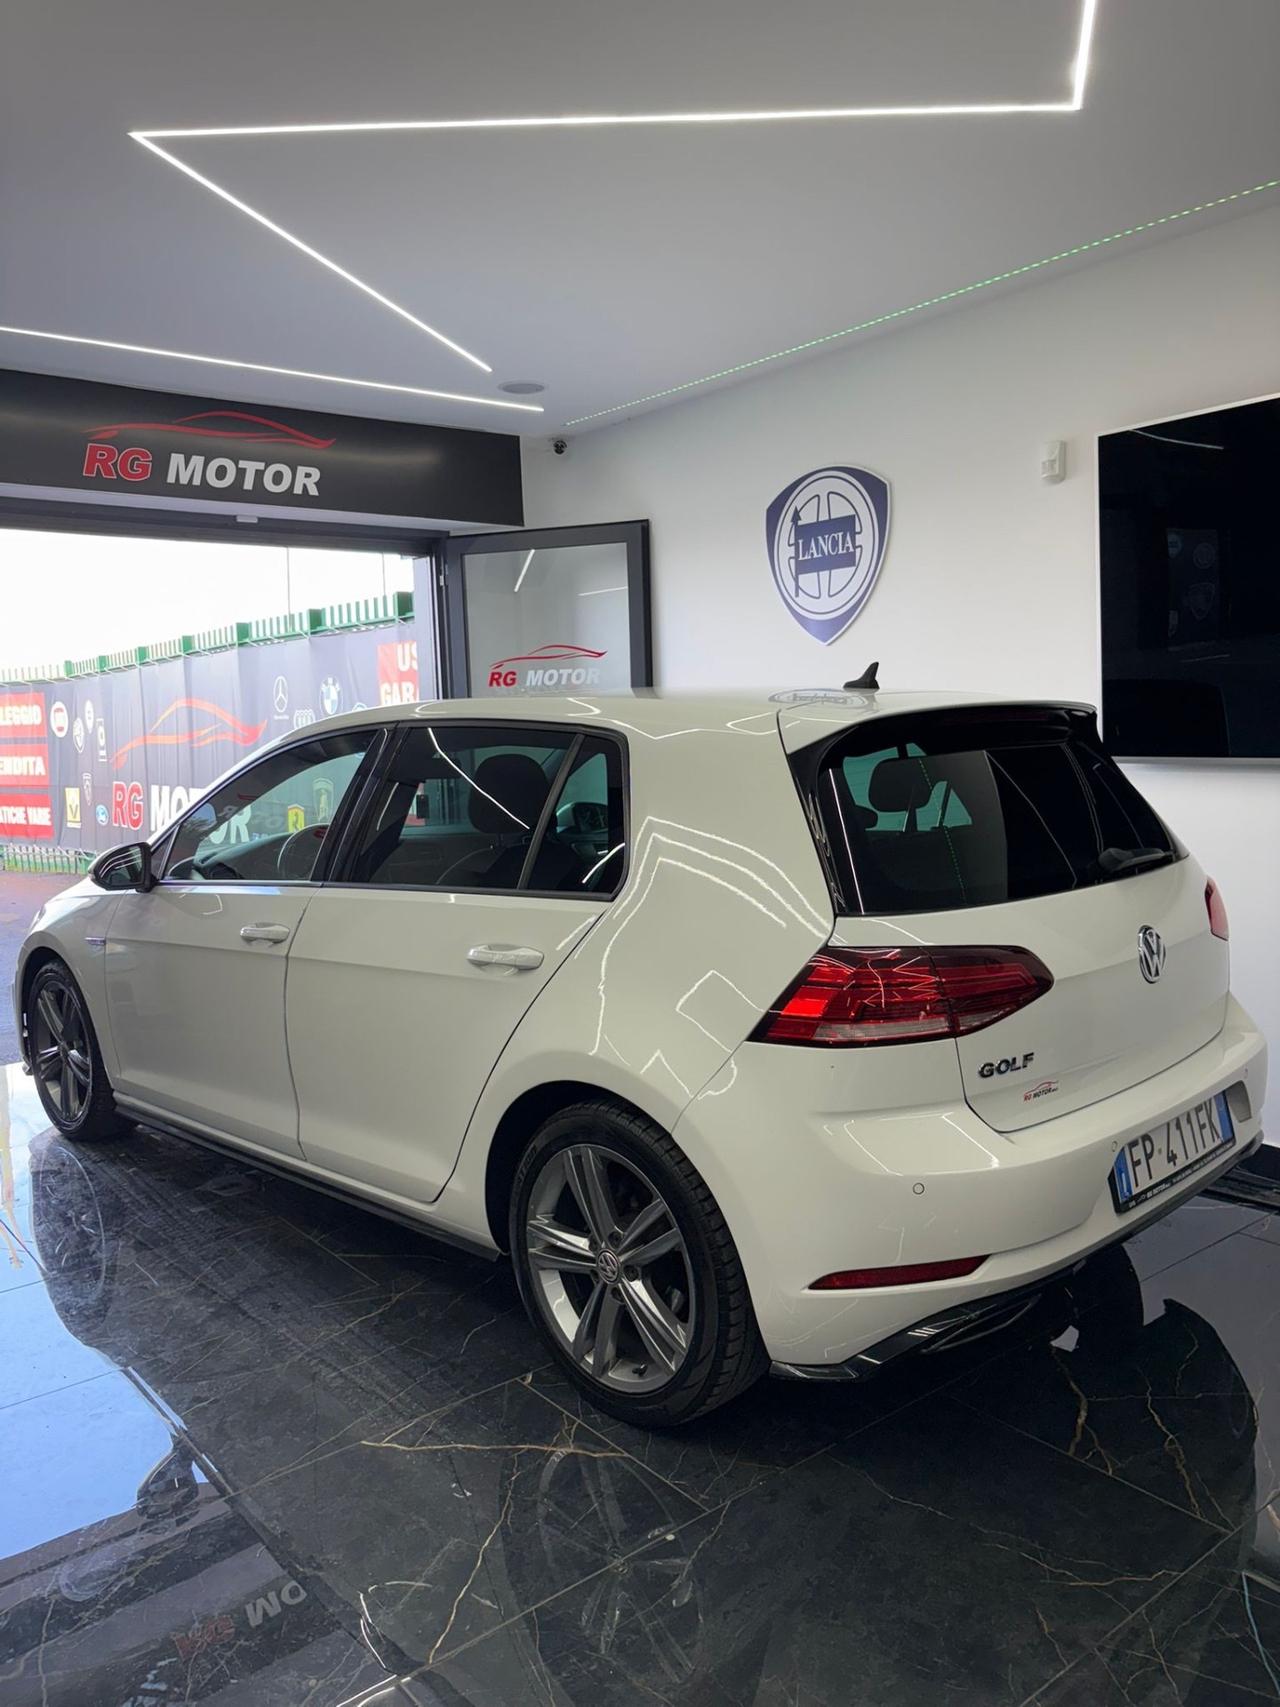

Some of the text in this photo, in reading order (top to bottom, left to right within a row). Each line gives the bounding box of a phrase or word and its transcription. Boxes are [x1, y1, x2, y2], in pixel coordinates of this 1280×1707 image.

[83, 443, 321, 496] RG MOTOR
[798, 531, 855, 560] LANCIA
[488, 668, 600, 687] RG MOTOR
[380, 681, 420, 706] GAR
[112, 781, 144, 831] RG
[978, 1052, 1035, 1078] GOLF
[1128, 1132, 1155, 1188] FP
[1166, 1097, 1222, 1167] 411FK
